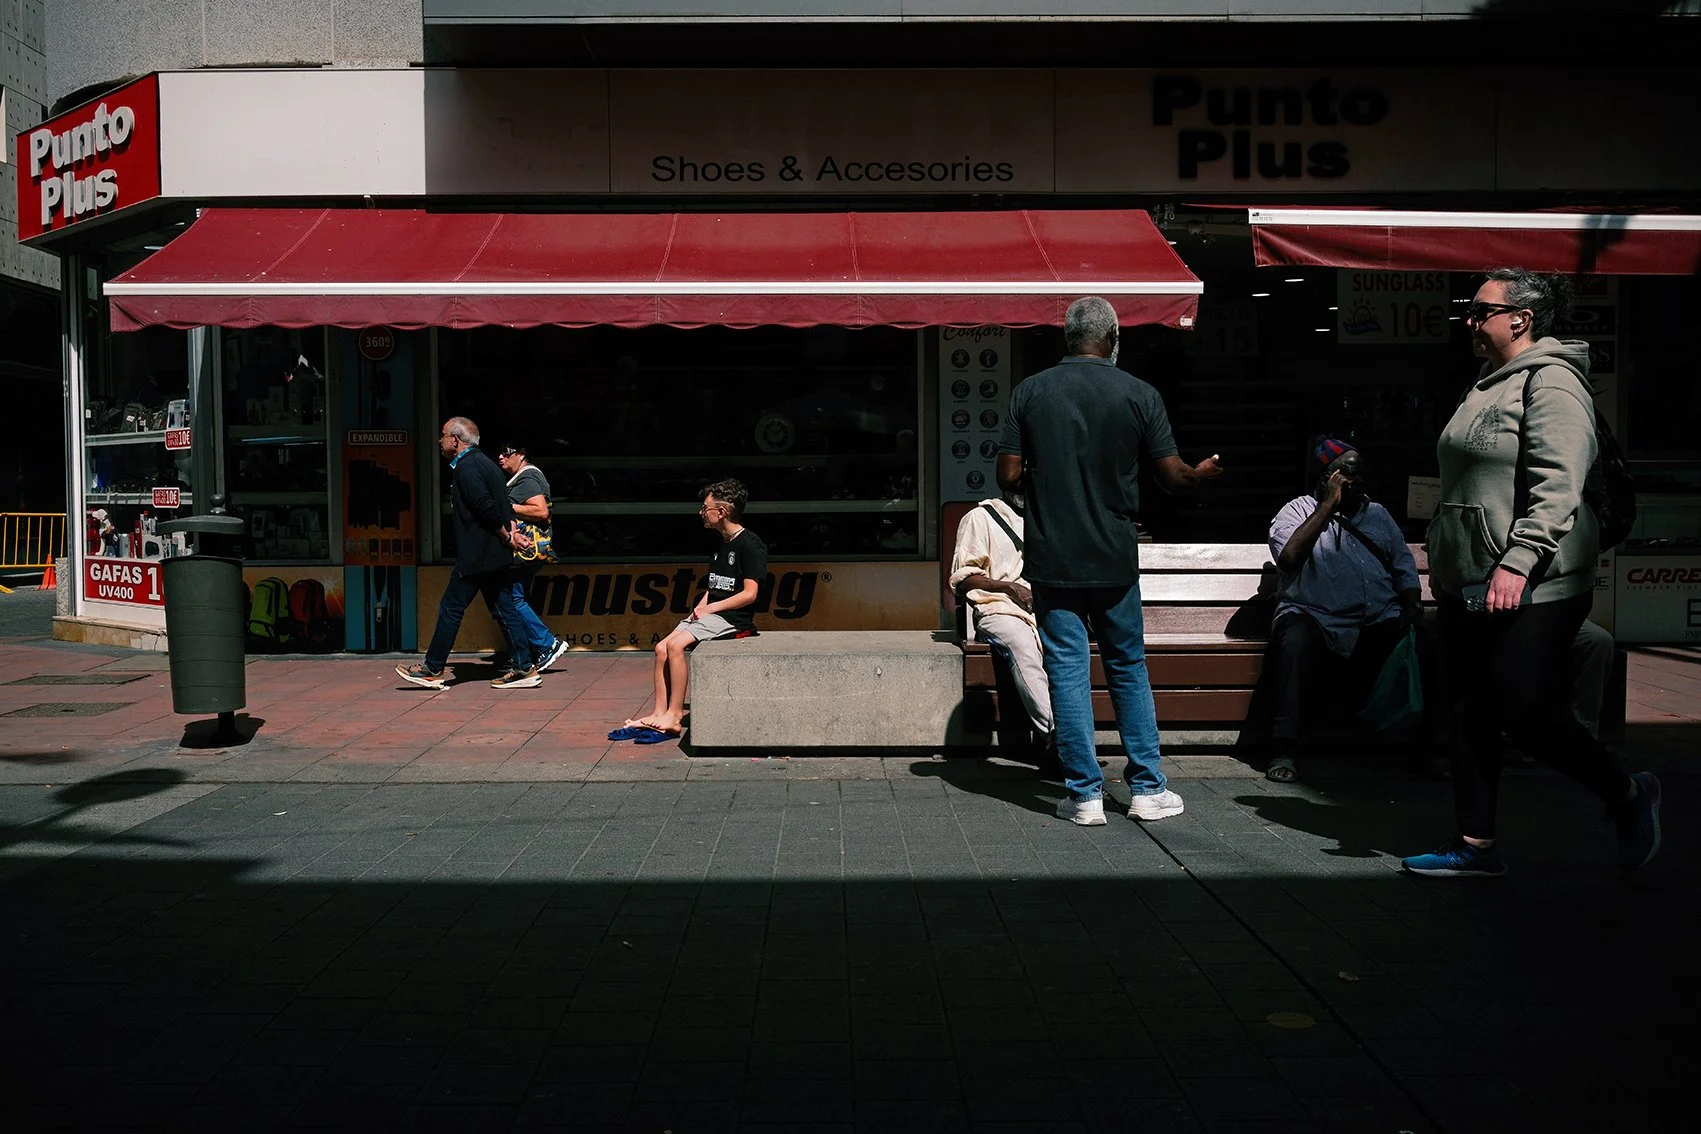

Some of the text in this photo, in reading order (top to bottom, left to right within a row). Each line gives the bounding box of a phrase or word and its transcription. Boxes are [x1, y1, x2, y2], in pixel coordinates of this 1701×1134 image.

[1154, 76, 1388, 125] Punto
[30, 102, 135, 178] Punto
[1179, 130, 1350, 178] Plus
[651, 156, 1014, 181] Shoes & Accesories
[41, 169, 118, 226] Plus
[1353, 272, 1444, 291] SUNGLASS
[1390, 302, 1445, 338] 10€
[352, 433, 403, 443] EXPANDIBLE
[166, 490, 178, 505] 10€
[90, 563, 165, 601] GAFAS 1
[99, 584, 134, 600] UV400
[557, 633, 617, 645] HOES
[629, 633, 639, 645] &
